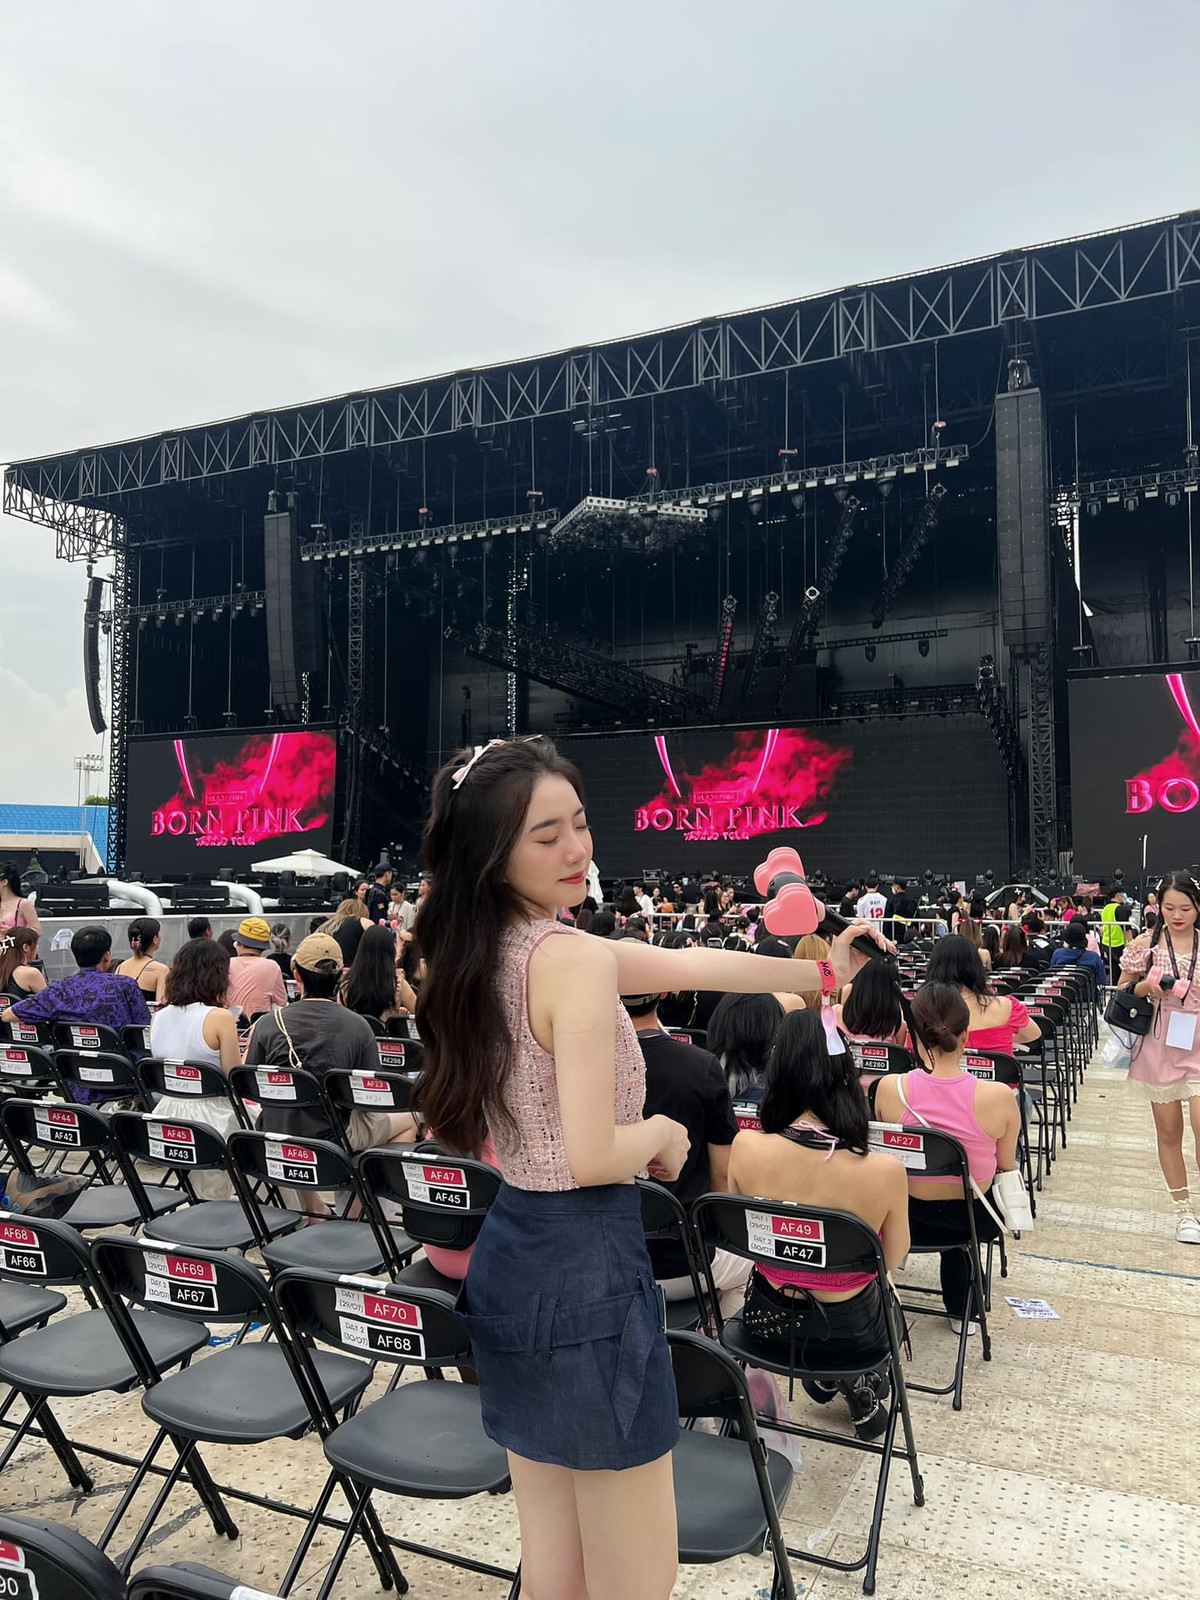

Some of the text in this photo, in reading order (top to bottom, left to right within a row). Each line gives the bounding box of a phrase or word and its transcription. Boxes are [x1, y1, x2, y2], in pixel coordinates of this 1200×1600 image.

[150, 807, 303, 835] BORN PINK
[634, 805, 804, 831] BORN PINK
[180, 1069, 195, 1077] AF21
[271, 1075, 288, 1083] AF22
[366, 1080, 384, 1088] AF23
[52, 1112, 71, 1123] AF44
[54, 1131, 73, 1142] AF42
[167, 1129, 187, 1139] AF45
[889, 1135, 914, 1146] AF27
[168, 1149, 189, 1159] AF43
[287, 1148, 309, 1159] AF46
[288, 1168, 309, 1179] AF44
[430, 1171, 455, 1182] AF47
[435, 1192, 461, 1204] AF45
[751, 1213, 764, 1221] DAY
[4, 1227, 28, 1240] AF68
[780, 1222, 812, 1235] AF49
[753, 1235, 767, 1243] DAY
[783, 1245, 814, 1260] AF47
[11, 1255, 37, 1268] AF66
[175, 1262, 204, 1276] AF69
[176, 1288, 205, 1303] AF67
[341, 1290, 356, 1299] DAY
[373, 1303, 407, 1320] AF70
[345, 1322, 359, 1332] DAY
[377, 1334, 412, 1351] AF68
